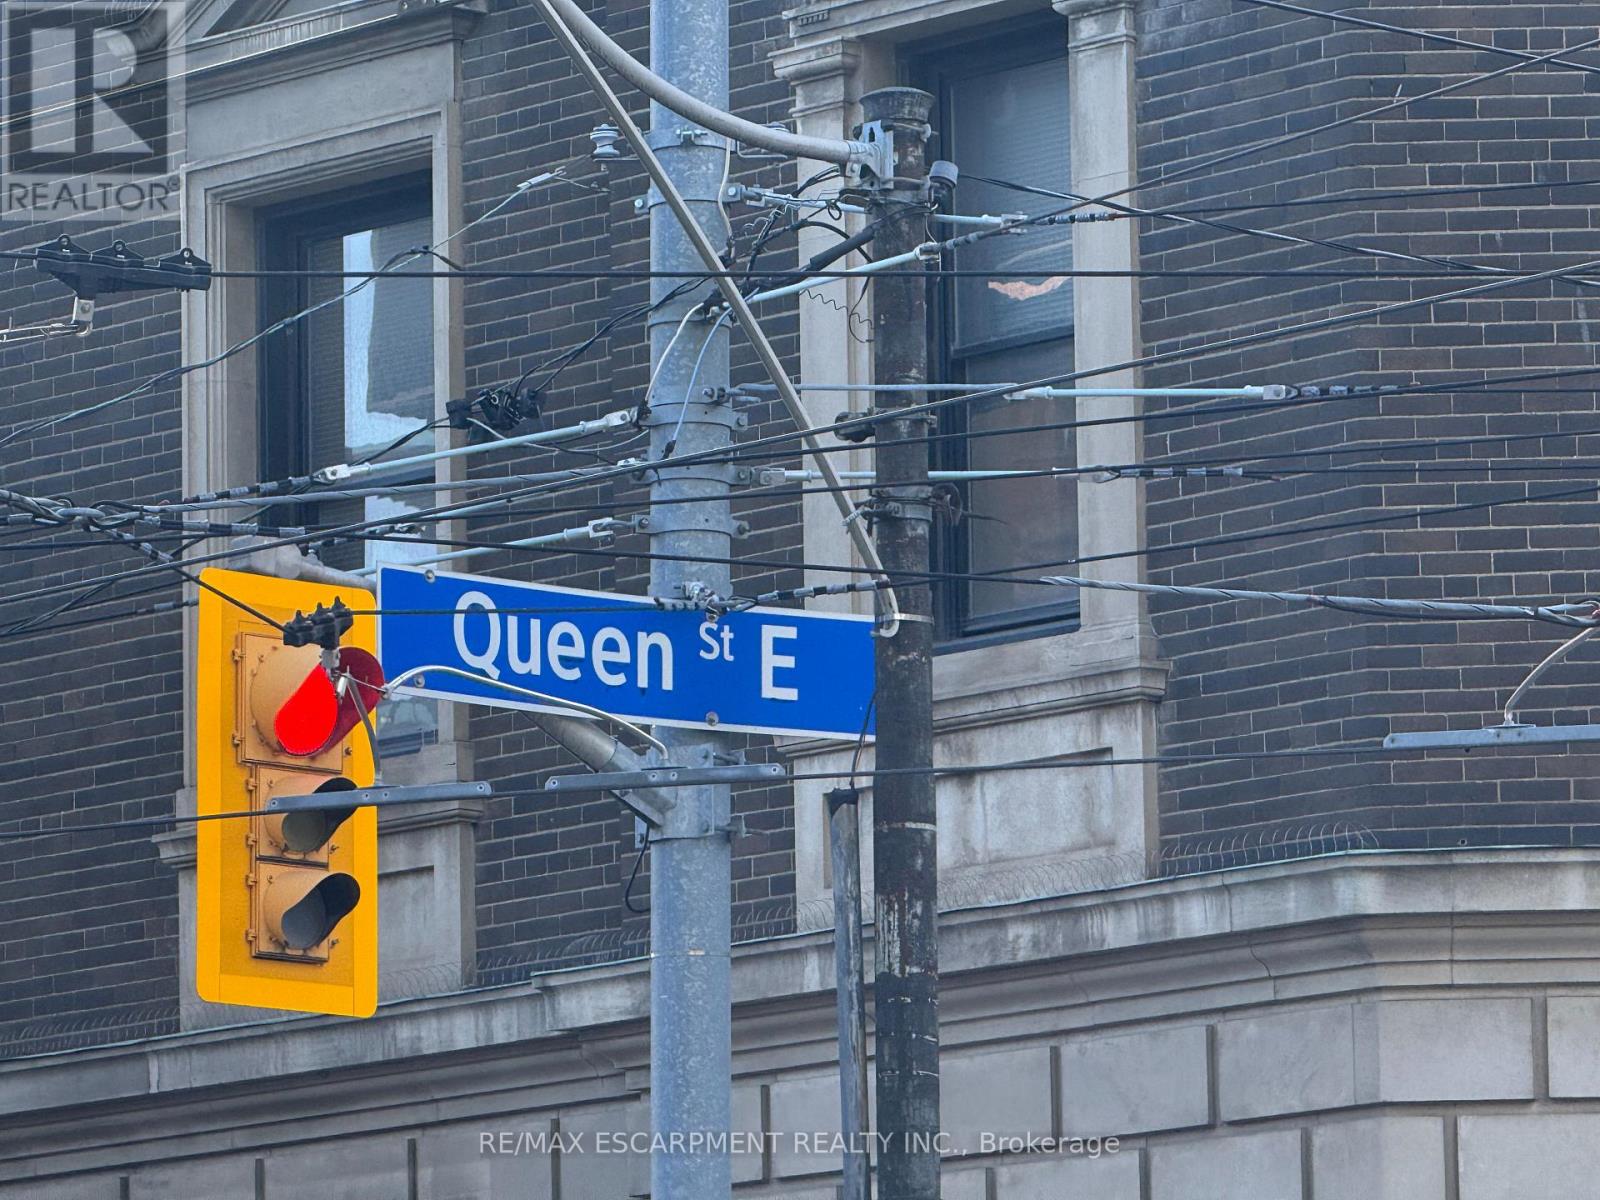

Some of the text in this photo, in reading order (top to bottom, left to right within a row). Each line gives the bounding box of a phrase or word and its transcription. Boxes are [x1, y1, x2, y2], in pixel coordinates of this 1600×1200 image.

[453, 590, 799, 701] Queen St E
